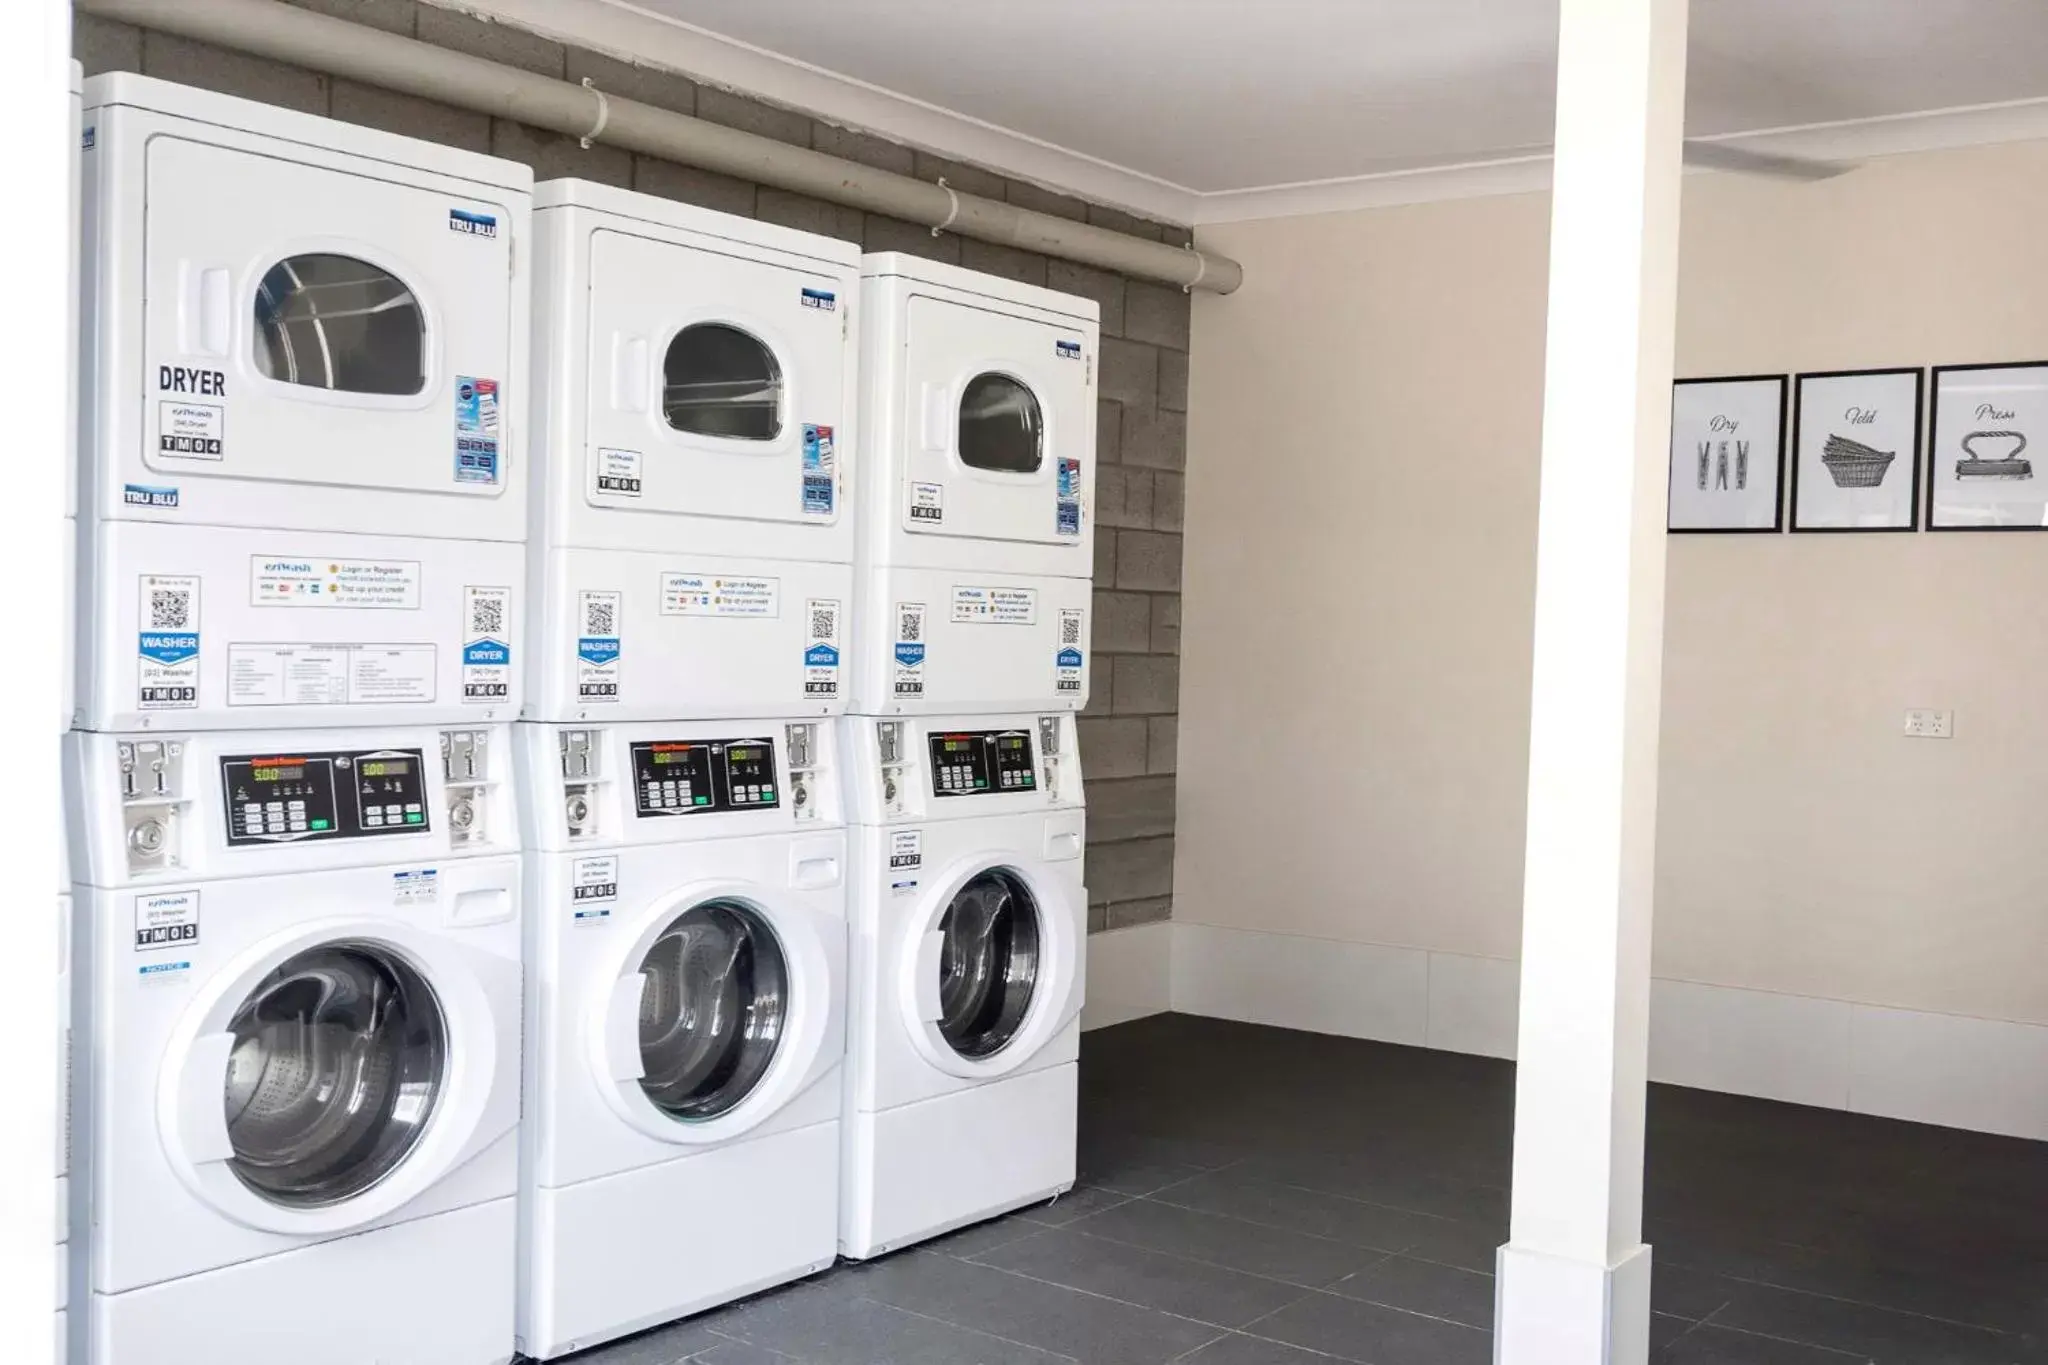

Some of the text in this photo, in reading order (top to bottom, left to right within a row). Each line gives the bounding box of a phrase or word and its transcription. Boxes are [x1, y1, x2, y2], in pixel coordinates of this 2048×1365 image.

[449, 218, 497, 237] TRU BLU
[159, 365, 225, 397] DRYER
[1845, 406, 1877, 425] Fold
[1974, 403, 2016, 421] Press
[1710, 414, 1740, 435] Dry
[161, 436, 221, 454] TM04
[124, 491, 178, 506] TRU BLU
[142, 637, 196, 649] WASHER
[580, 642, 618, 652] WASHER
[469, 650, 504, 661] DRYER
[142, 687, 195, 701] TM03
[575, 883, 617, 899] TM05
[137, 924, 197, 944] TM03
